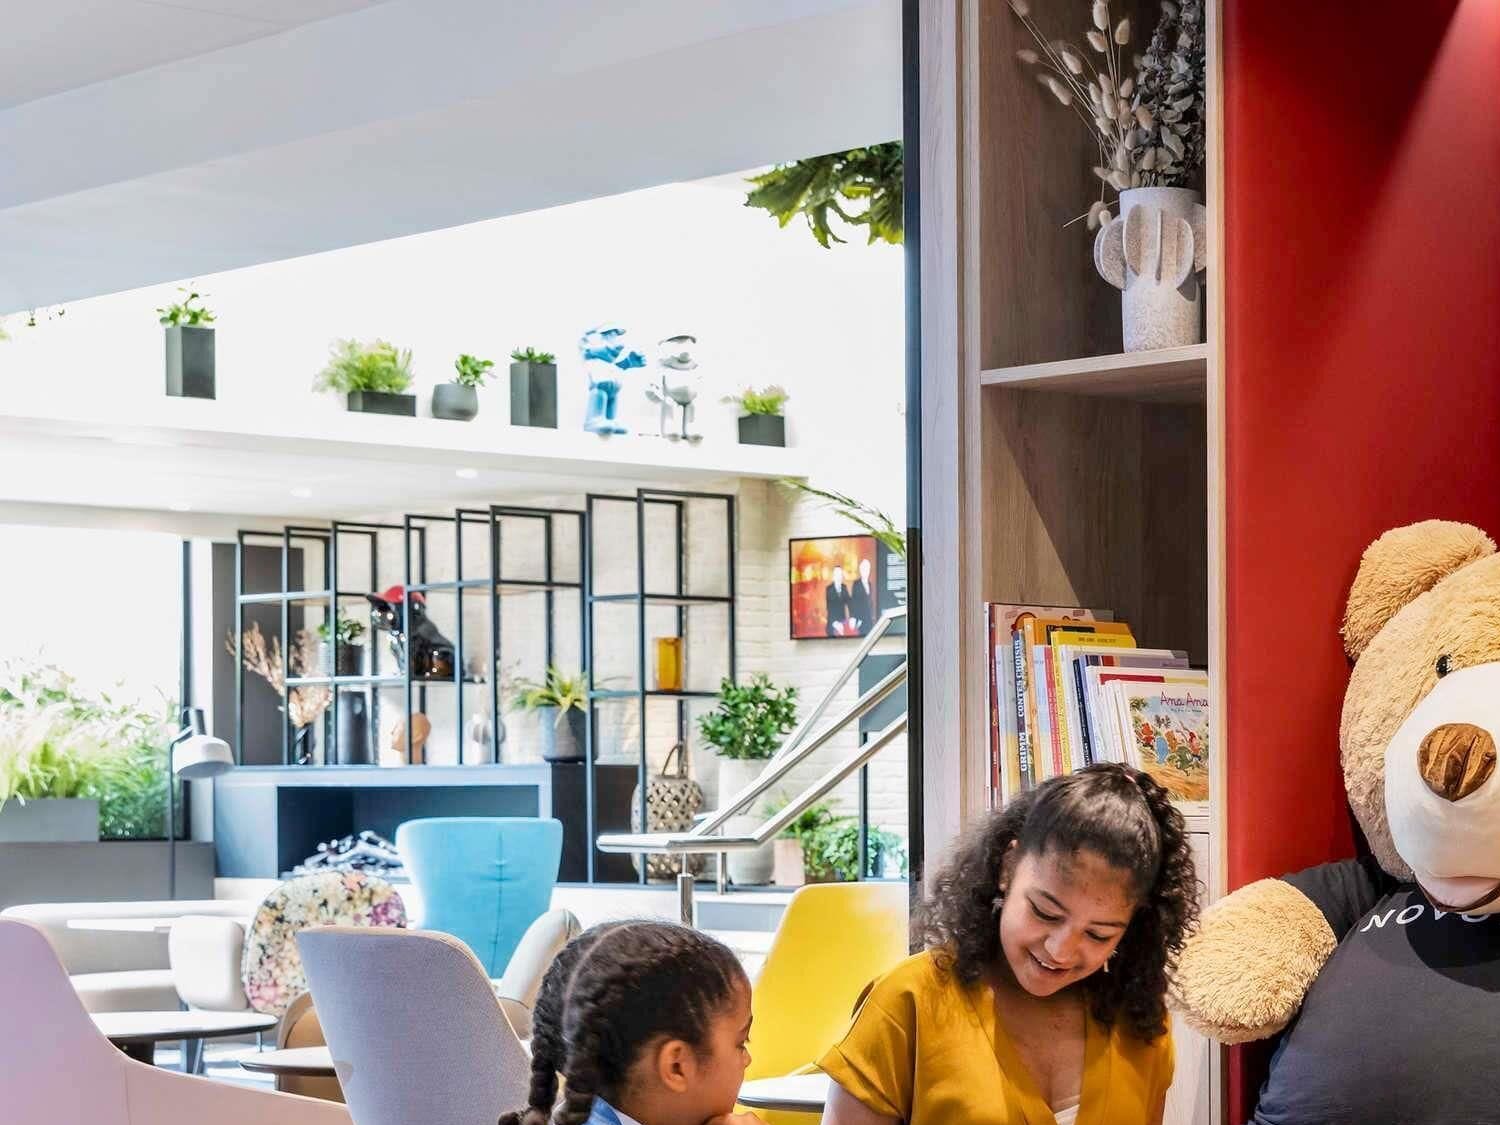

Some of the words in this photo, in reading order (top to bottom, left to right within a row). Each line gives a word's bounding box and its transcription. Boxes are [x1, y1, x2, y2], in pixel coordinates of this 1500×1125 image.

[1014, 639, 1023, 680] CHOISIS
[1016, 681, 1025, 718] CONTES
[1160, 690, 1184, 707] Ama
[1019, 731, 1028, 772] GRIMM
